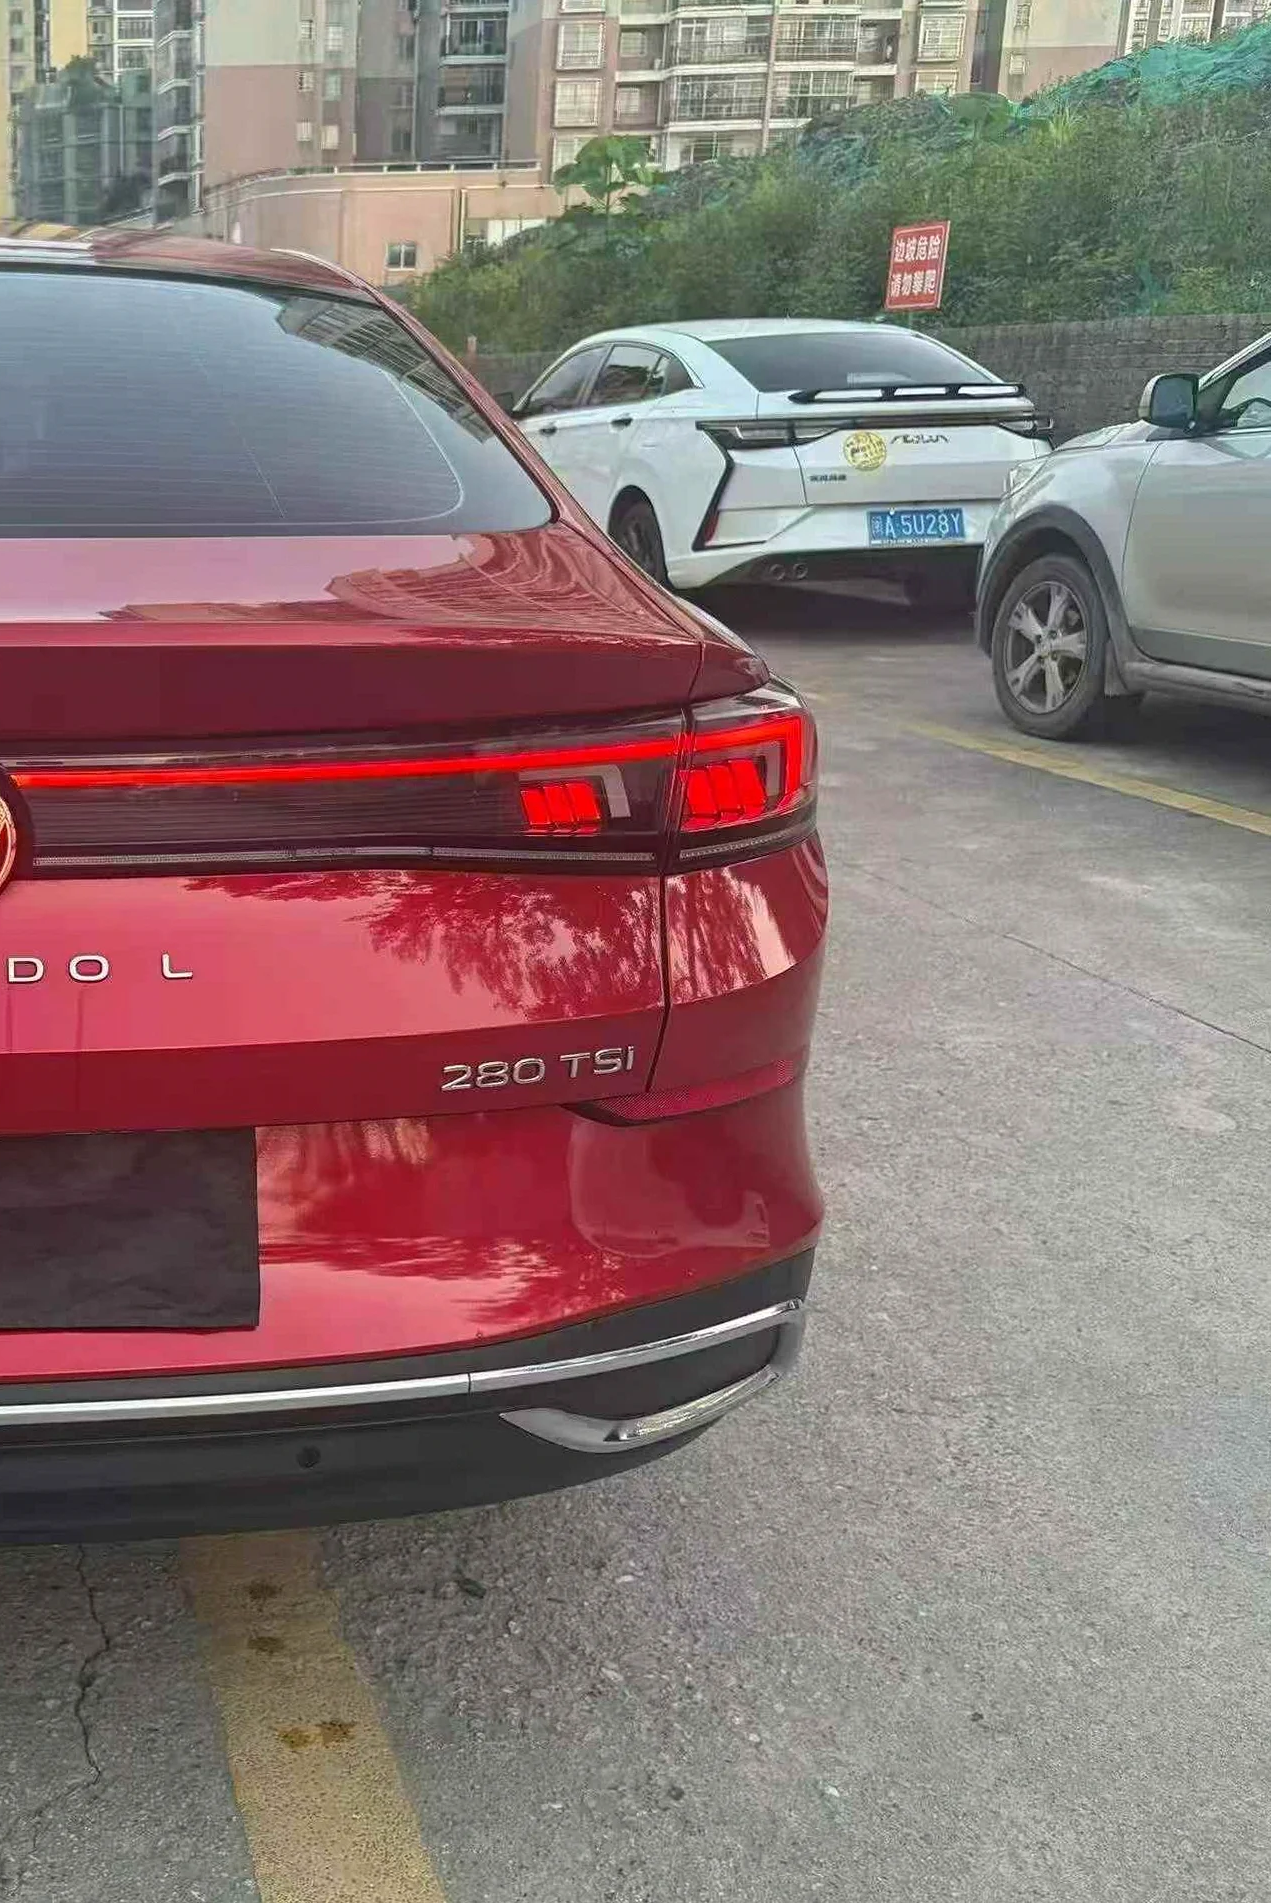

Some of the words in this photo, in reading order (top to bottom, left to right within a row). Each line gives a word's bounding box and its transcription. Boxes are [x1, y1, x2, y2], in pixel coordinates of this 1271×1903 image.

[894, 233, 940, 262] 边坡危险
[890, 269, 936, 297] 请勿攀爬
[161, 953, 193, 980] L
[441, 1057, 545, 1092] 280
